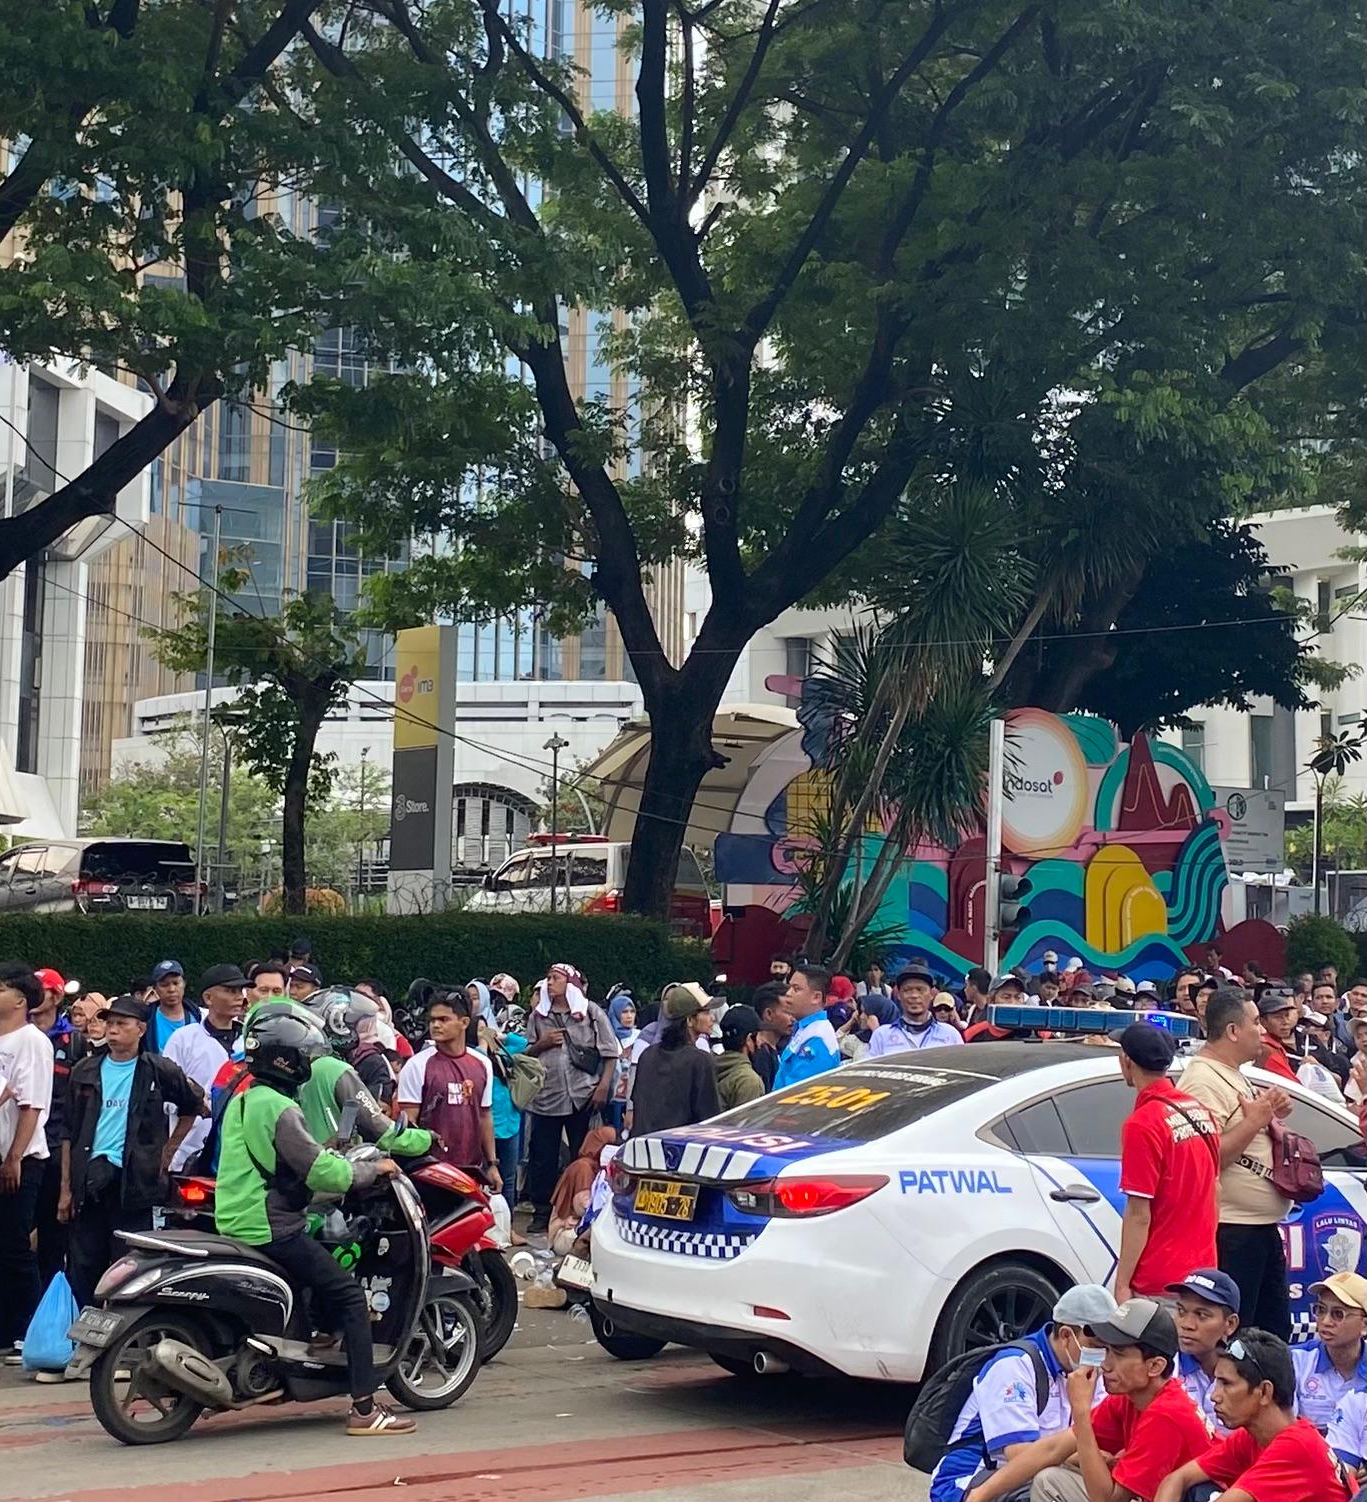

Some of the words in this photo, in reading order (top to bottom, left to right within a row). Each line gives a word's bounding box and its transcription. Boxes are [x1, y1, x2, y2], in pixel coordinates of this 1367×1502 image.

[105, 1099, 125, 1109] DAY
[670, 1127, 813, 1153] OLISI
[898, 1170, 1013, 1194] PATWAL
[156, 1287, 210, 1301] Scoopy
